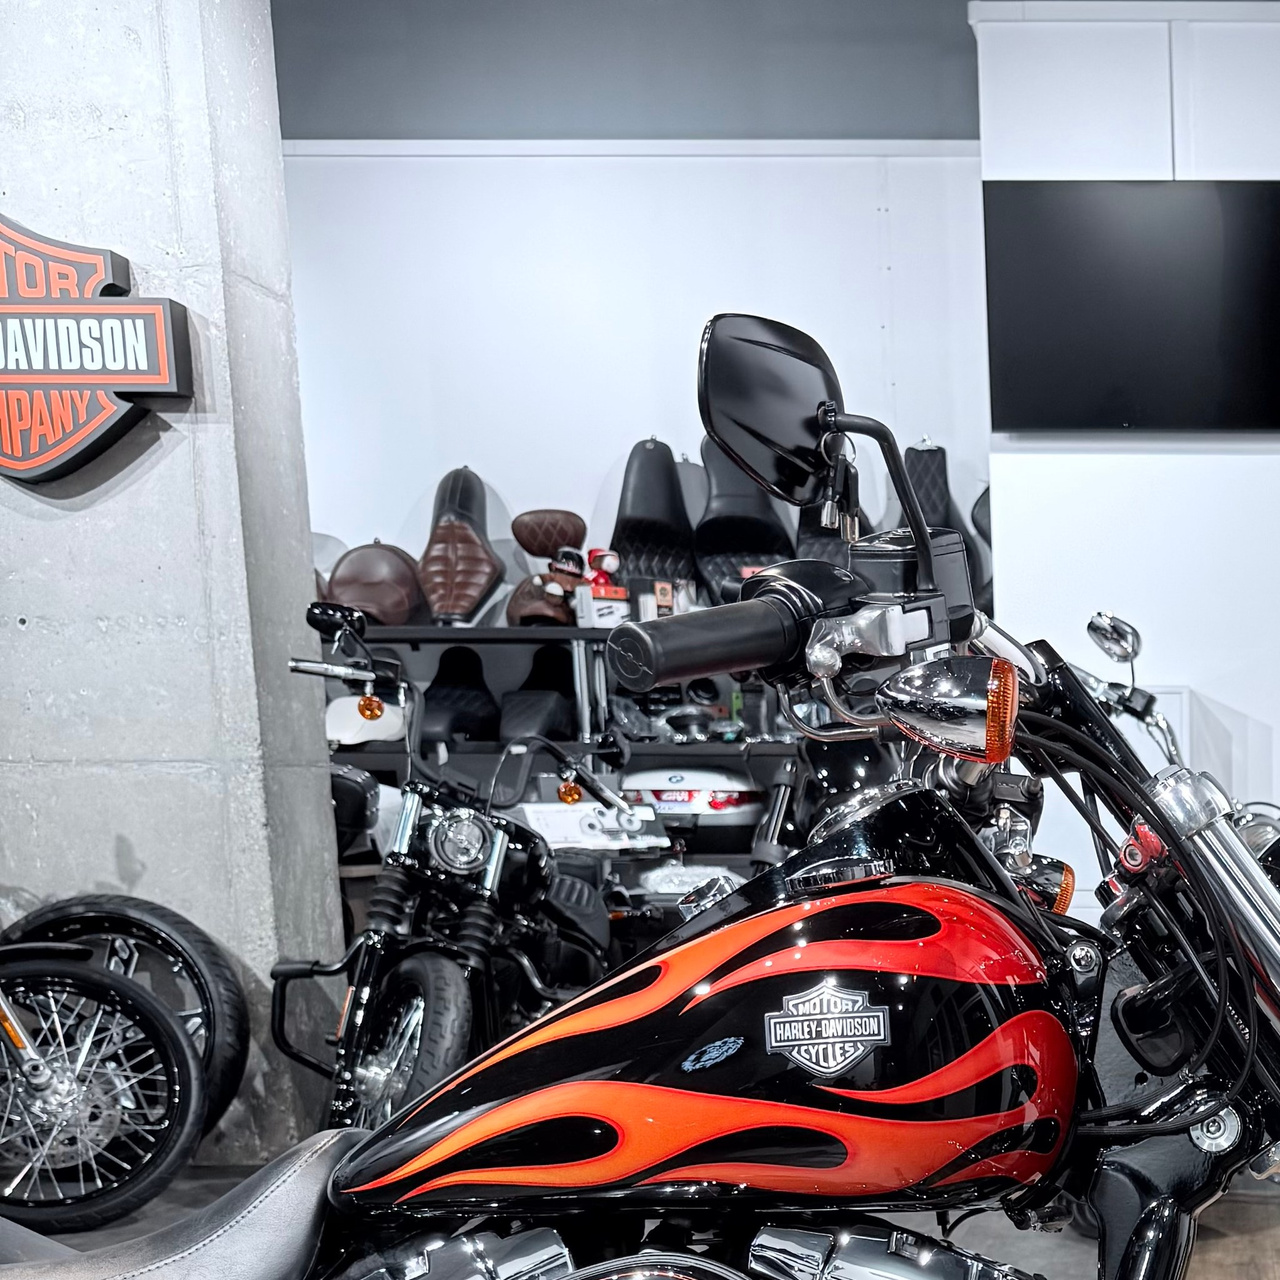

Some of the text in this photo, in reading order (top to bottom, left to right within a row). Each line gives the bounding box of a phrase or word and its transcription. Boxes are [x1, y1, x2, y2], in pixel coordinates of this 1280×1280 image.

[0, 318, 148, 371] AVIDSON
[798, 996, 853, 1016] MOTOR
[776, 1016, 878, 1042] HARLEY-DAVIDSON
[801, 1042, 855, 1067] CYCLES
